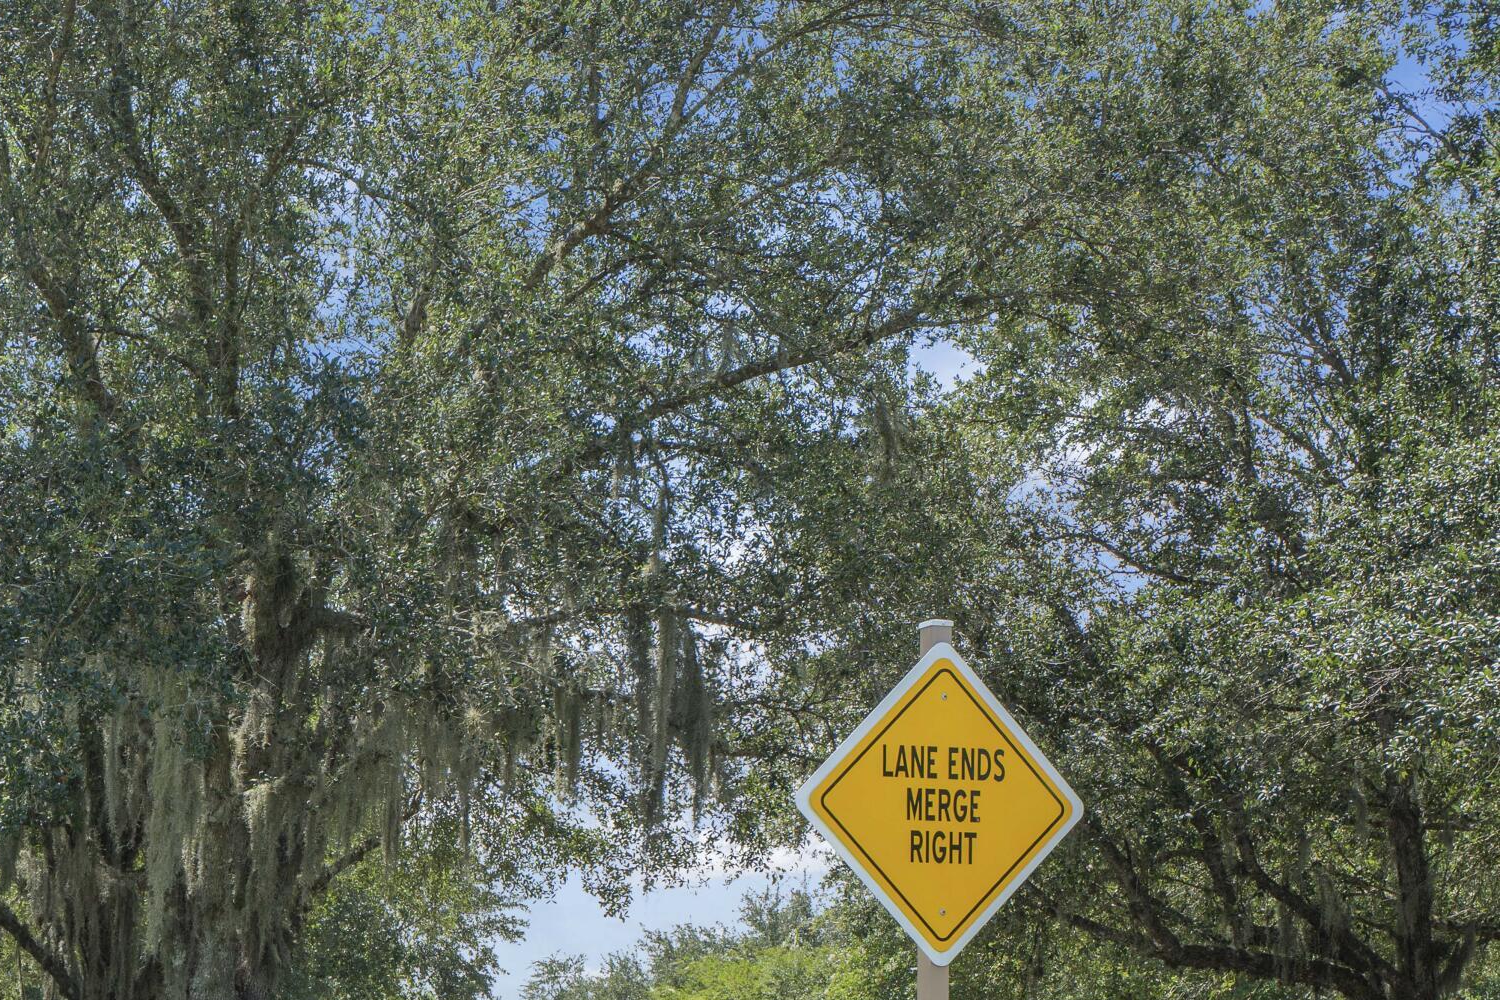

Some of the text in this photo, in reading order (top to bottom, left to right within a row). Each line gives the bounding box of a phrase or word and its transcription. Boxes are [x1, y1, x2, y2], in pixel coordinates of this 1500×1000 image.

[882, 744, 1005, 783] LANE ENDS
[906, 787, 981, 823] MERGE
[909, 830, 978, 865] RIGHT
